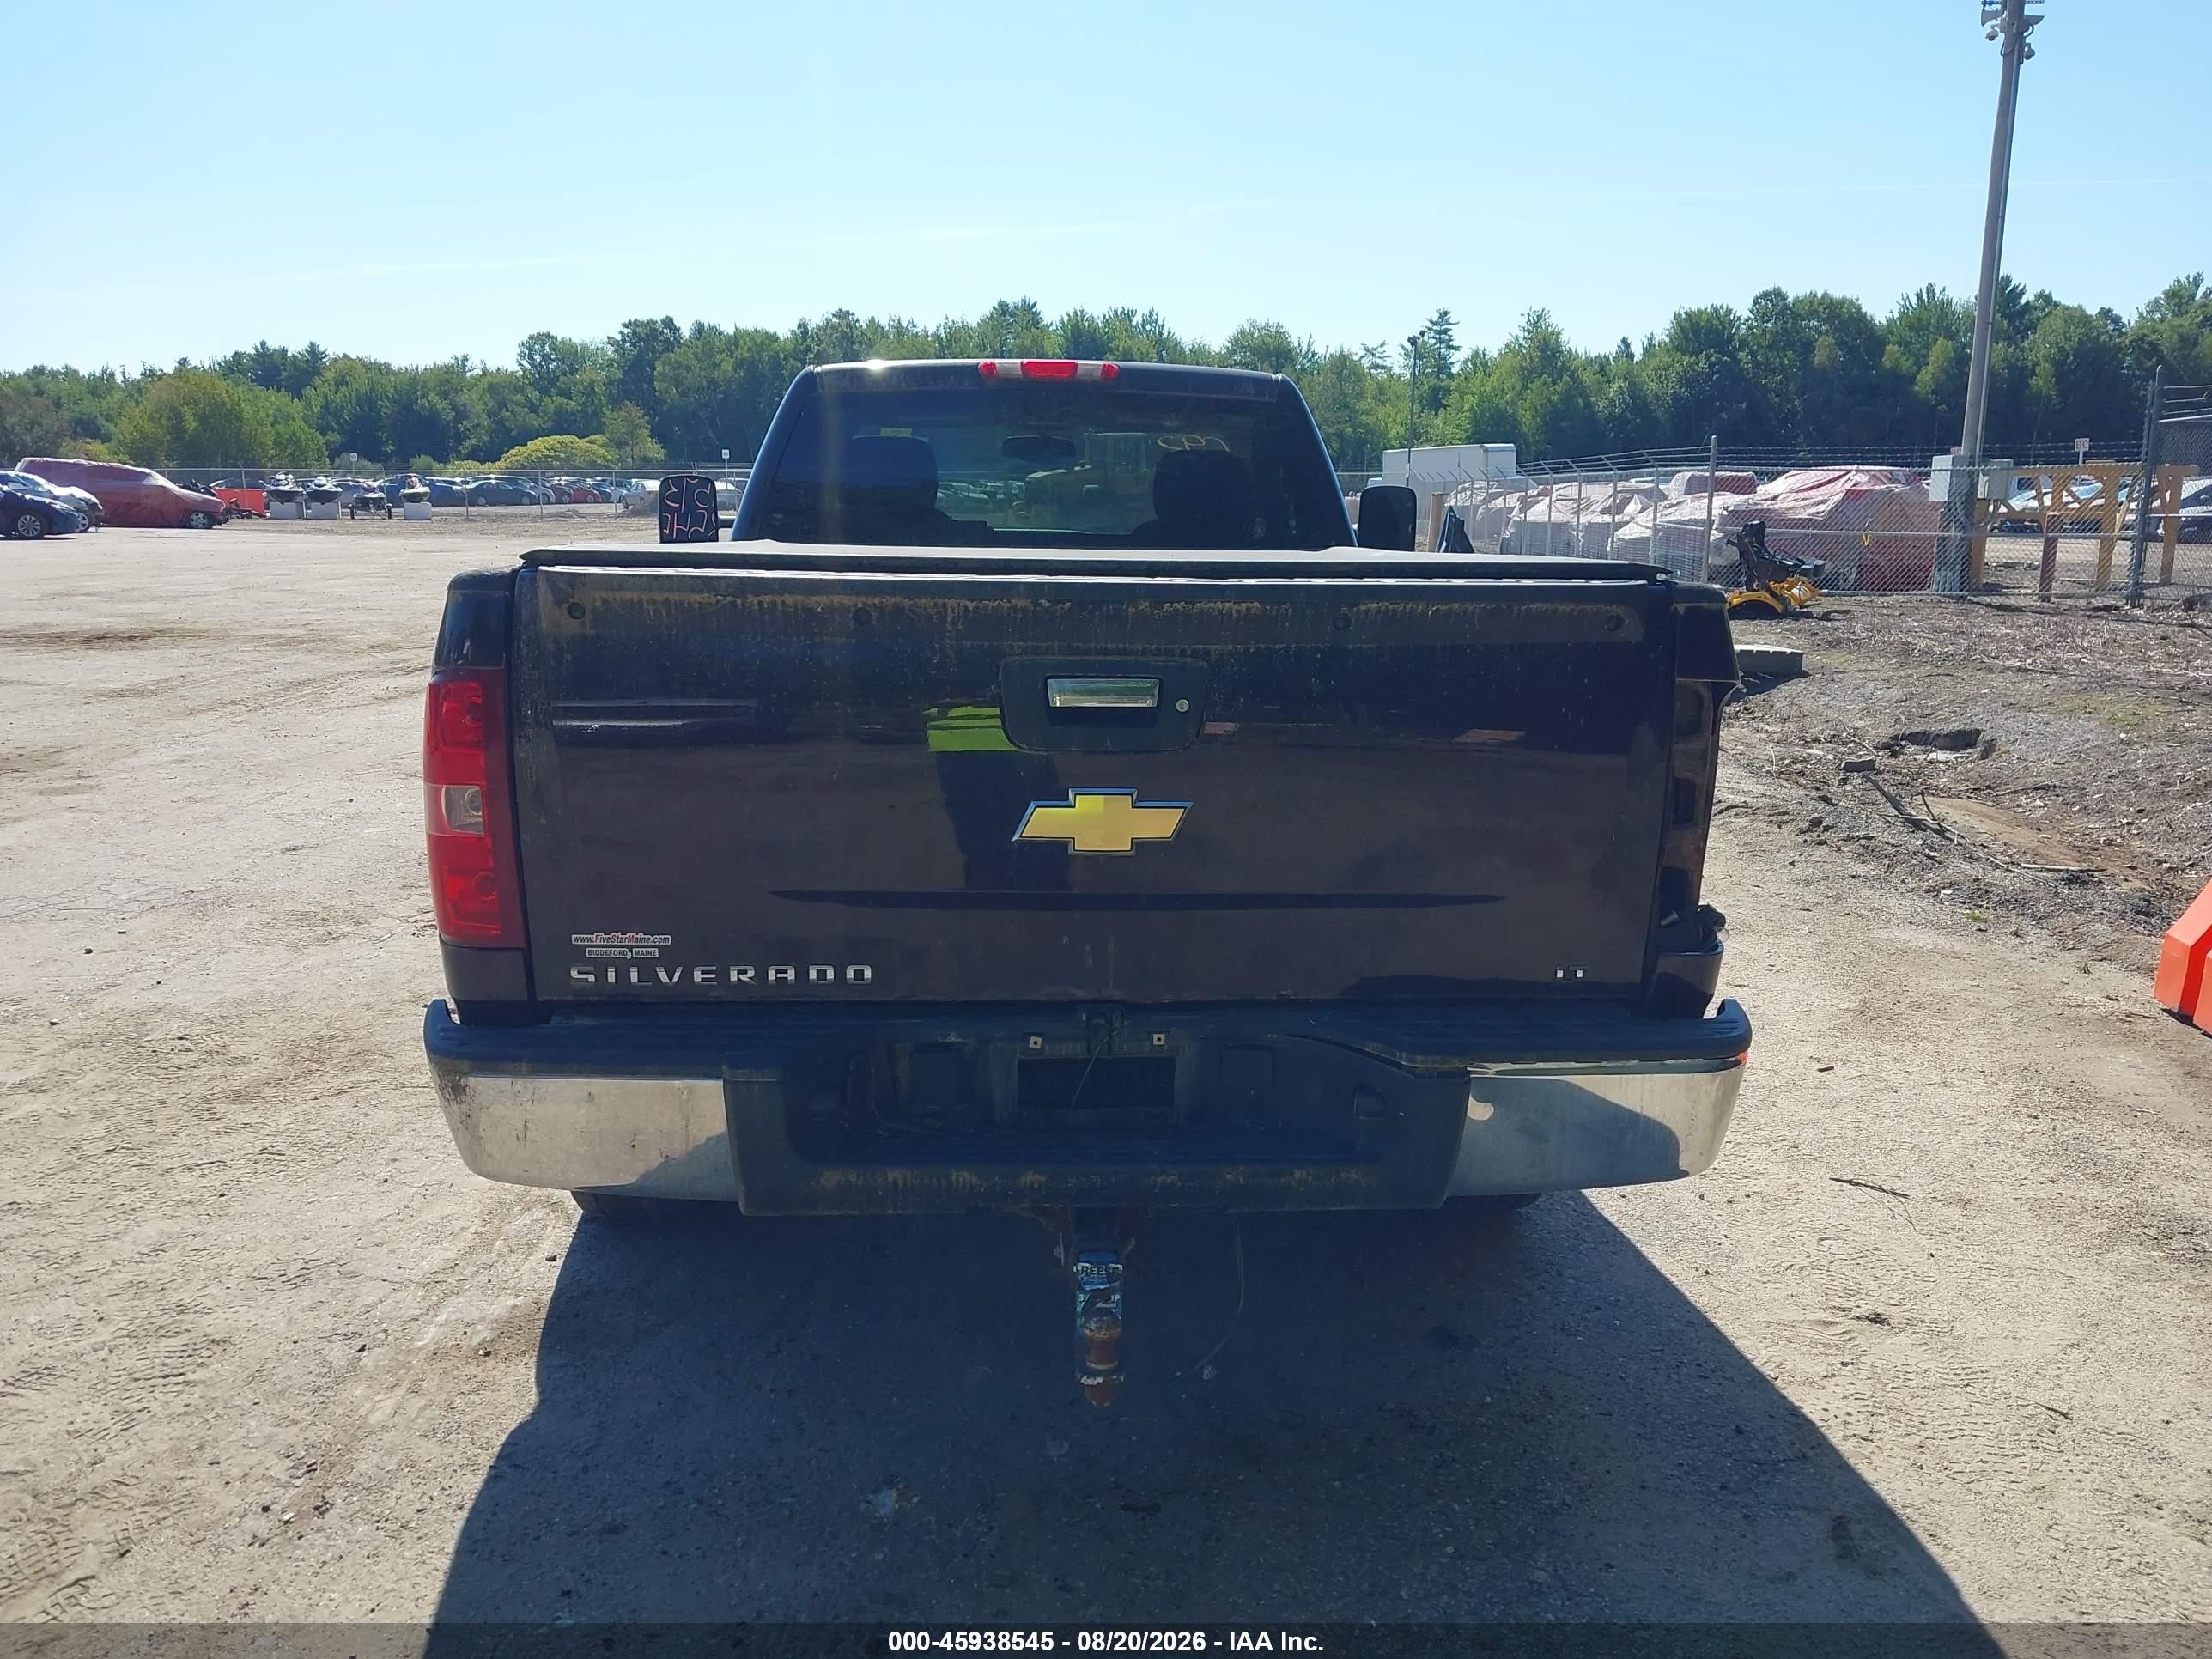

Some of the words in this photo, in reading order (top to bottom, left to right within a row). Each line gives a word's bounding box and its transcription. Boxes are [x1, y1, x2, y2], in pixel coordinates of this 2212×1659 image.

[572, 933, 671, 945] www.FiveStarMaine.com
[587, 949, 630, 958] BIDDEFORD,
[570, 965, 872, 985] SILVERADO
